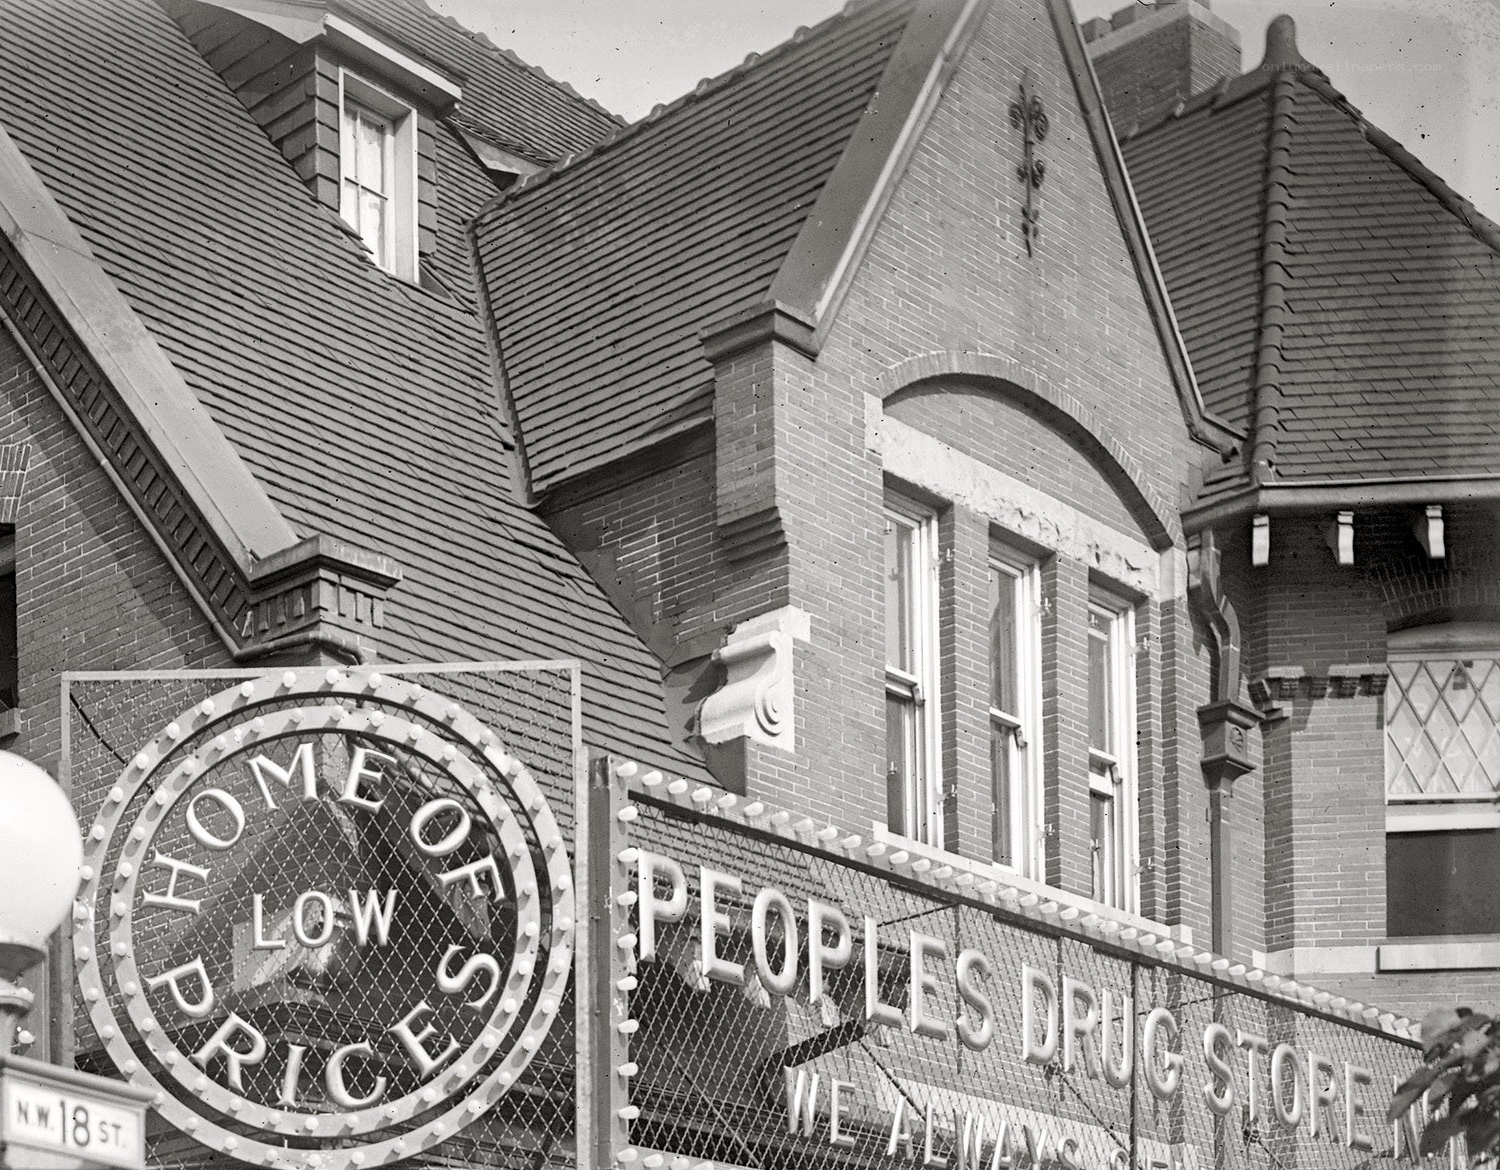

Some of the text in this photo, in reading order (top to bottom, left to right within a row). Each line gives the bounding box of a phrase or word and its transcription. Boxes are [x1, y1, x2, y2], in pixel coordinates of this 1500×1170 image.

[142, 742, 506, 915] HOME OF
[252, 889, 399, 952] LOW
[146, 942, 503, 1110] PRICES
[637, 848, 996, 1053] PEOPLES
[1021, 962, 1184, 1102] DRUG
[1203, 1023, 1373, 1154] STORE
[58, 1100, 92, 1146] 18
[784, 1064, 857, 1149] WE
